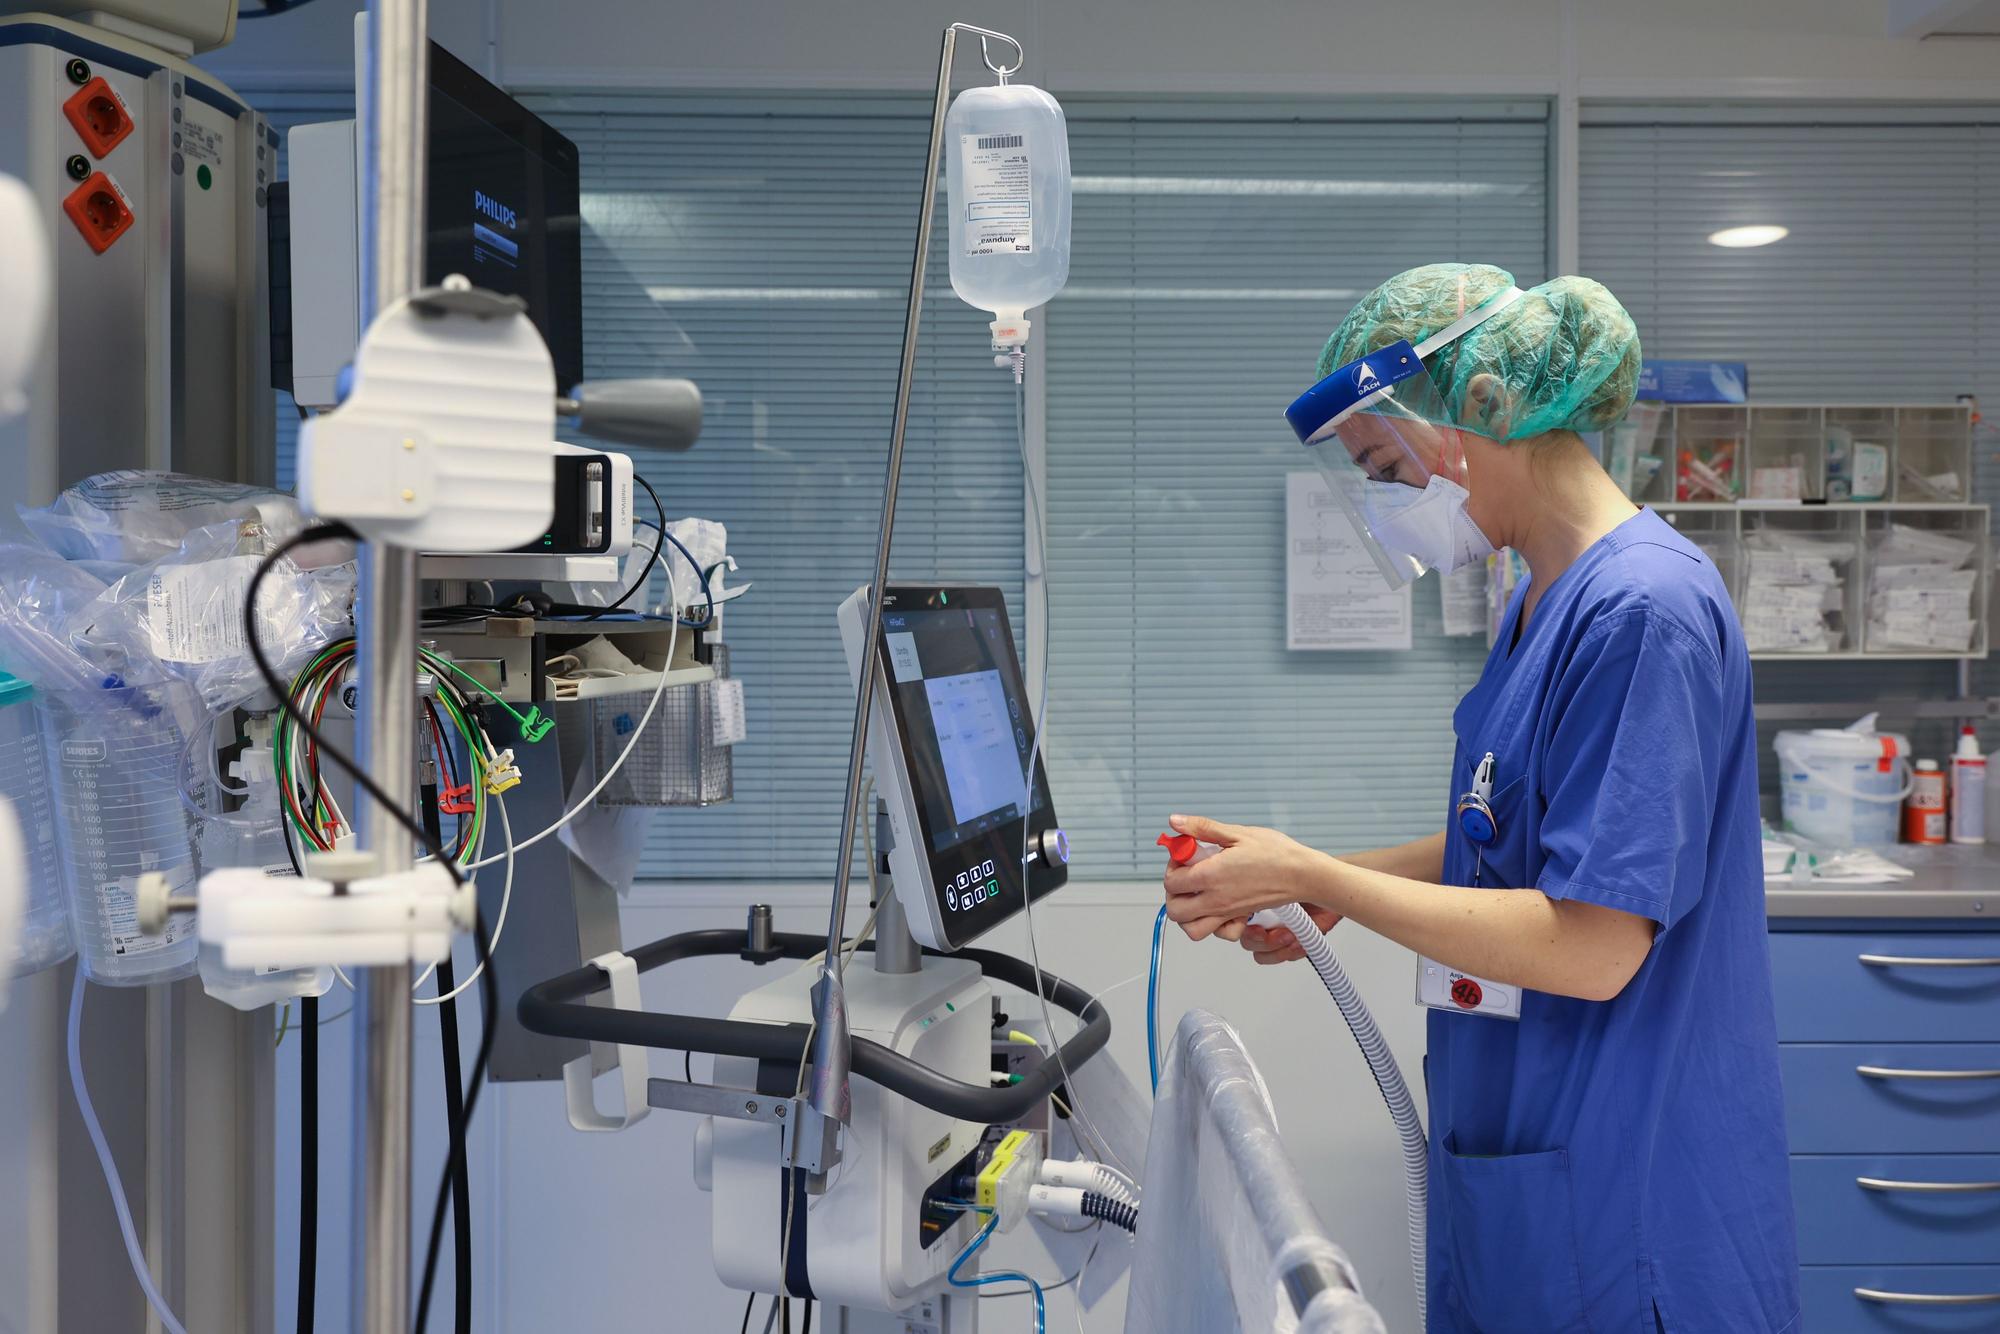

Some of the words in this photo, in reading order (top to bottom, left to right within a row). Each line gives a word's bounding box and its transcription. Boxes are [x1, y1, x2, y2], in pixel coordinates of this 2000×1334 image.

[475, 190, 516, 230] PHILIPS
[981, 236, 1016, 245] Ampuwa
[1358, 381, 1381, 396] DACH
[78, 781, 97, 789] 1700
[81, 803, 100, 811] 1500
[83, 815, 101, 824] 1400
[89, 862, 108, 870] 1000
[1455, 984, 1479, 1006] 4b
